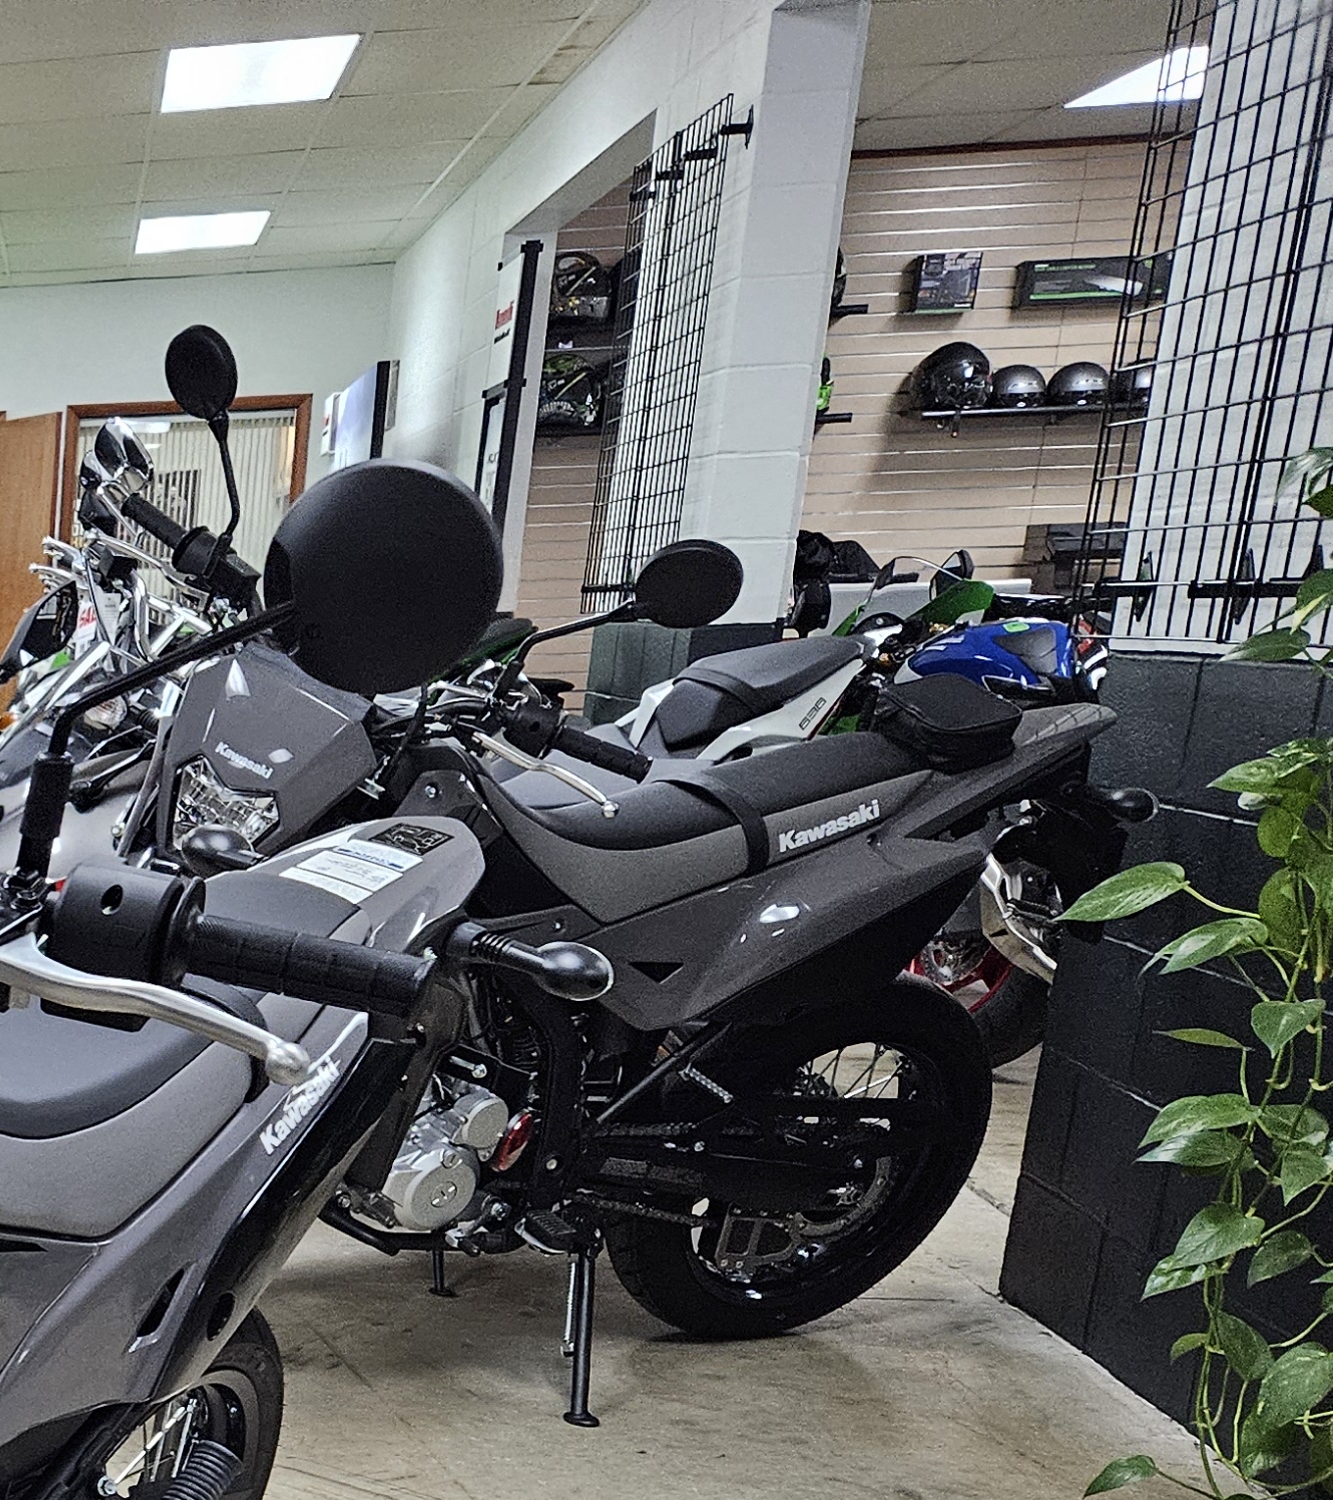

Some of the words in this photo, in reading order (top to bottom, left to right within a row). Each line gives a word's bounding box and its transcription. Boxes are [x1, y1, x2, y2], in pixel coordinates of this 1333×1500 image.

[214, 741, 274, 780] Kawasaki
[779, 799, 880, 853] Kawasaki
[259, 1055, 341, 1155] Kawasaki
